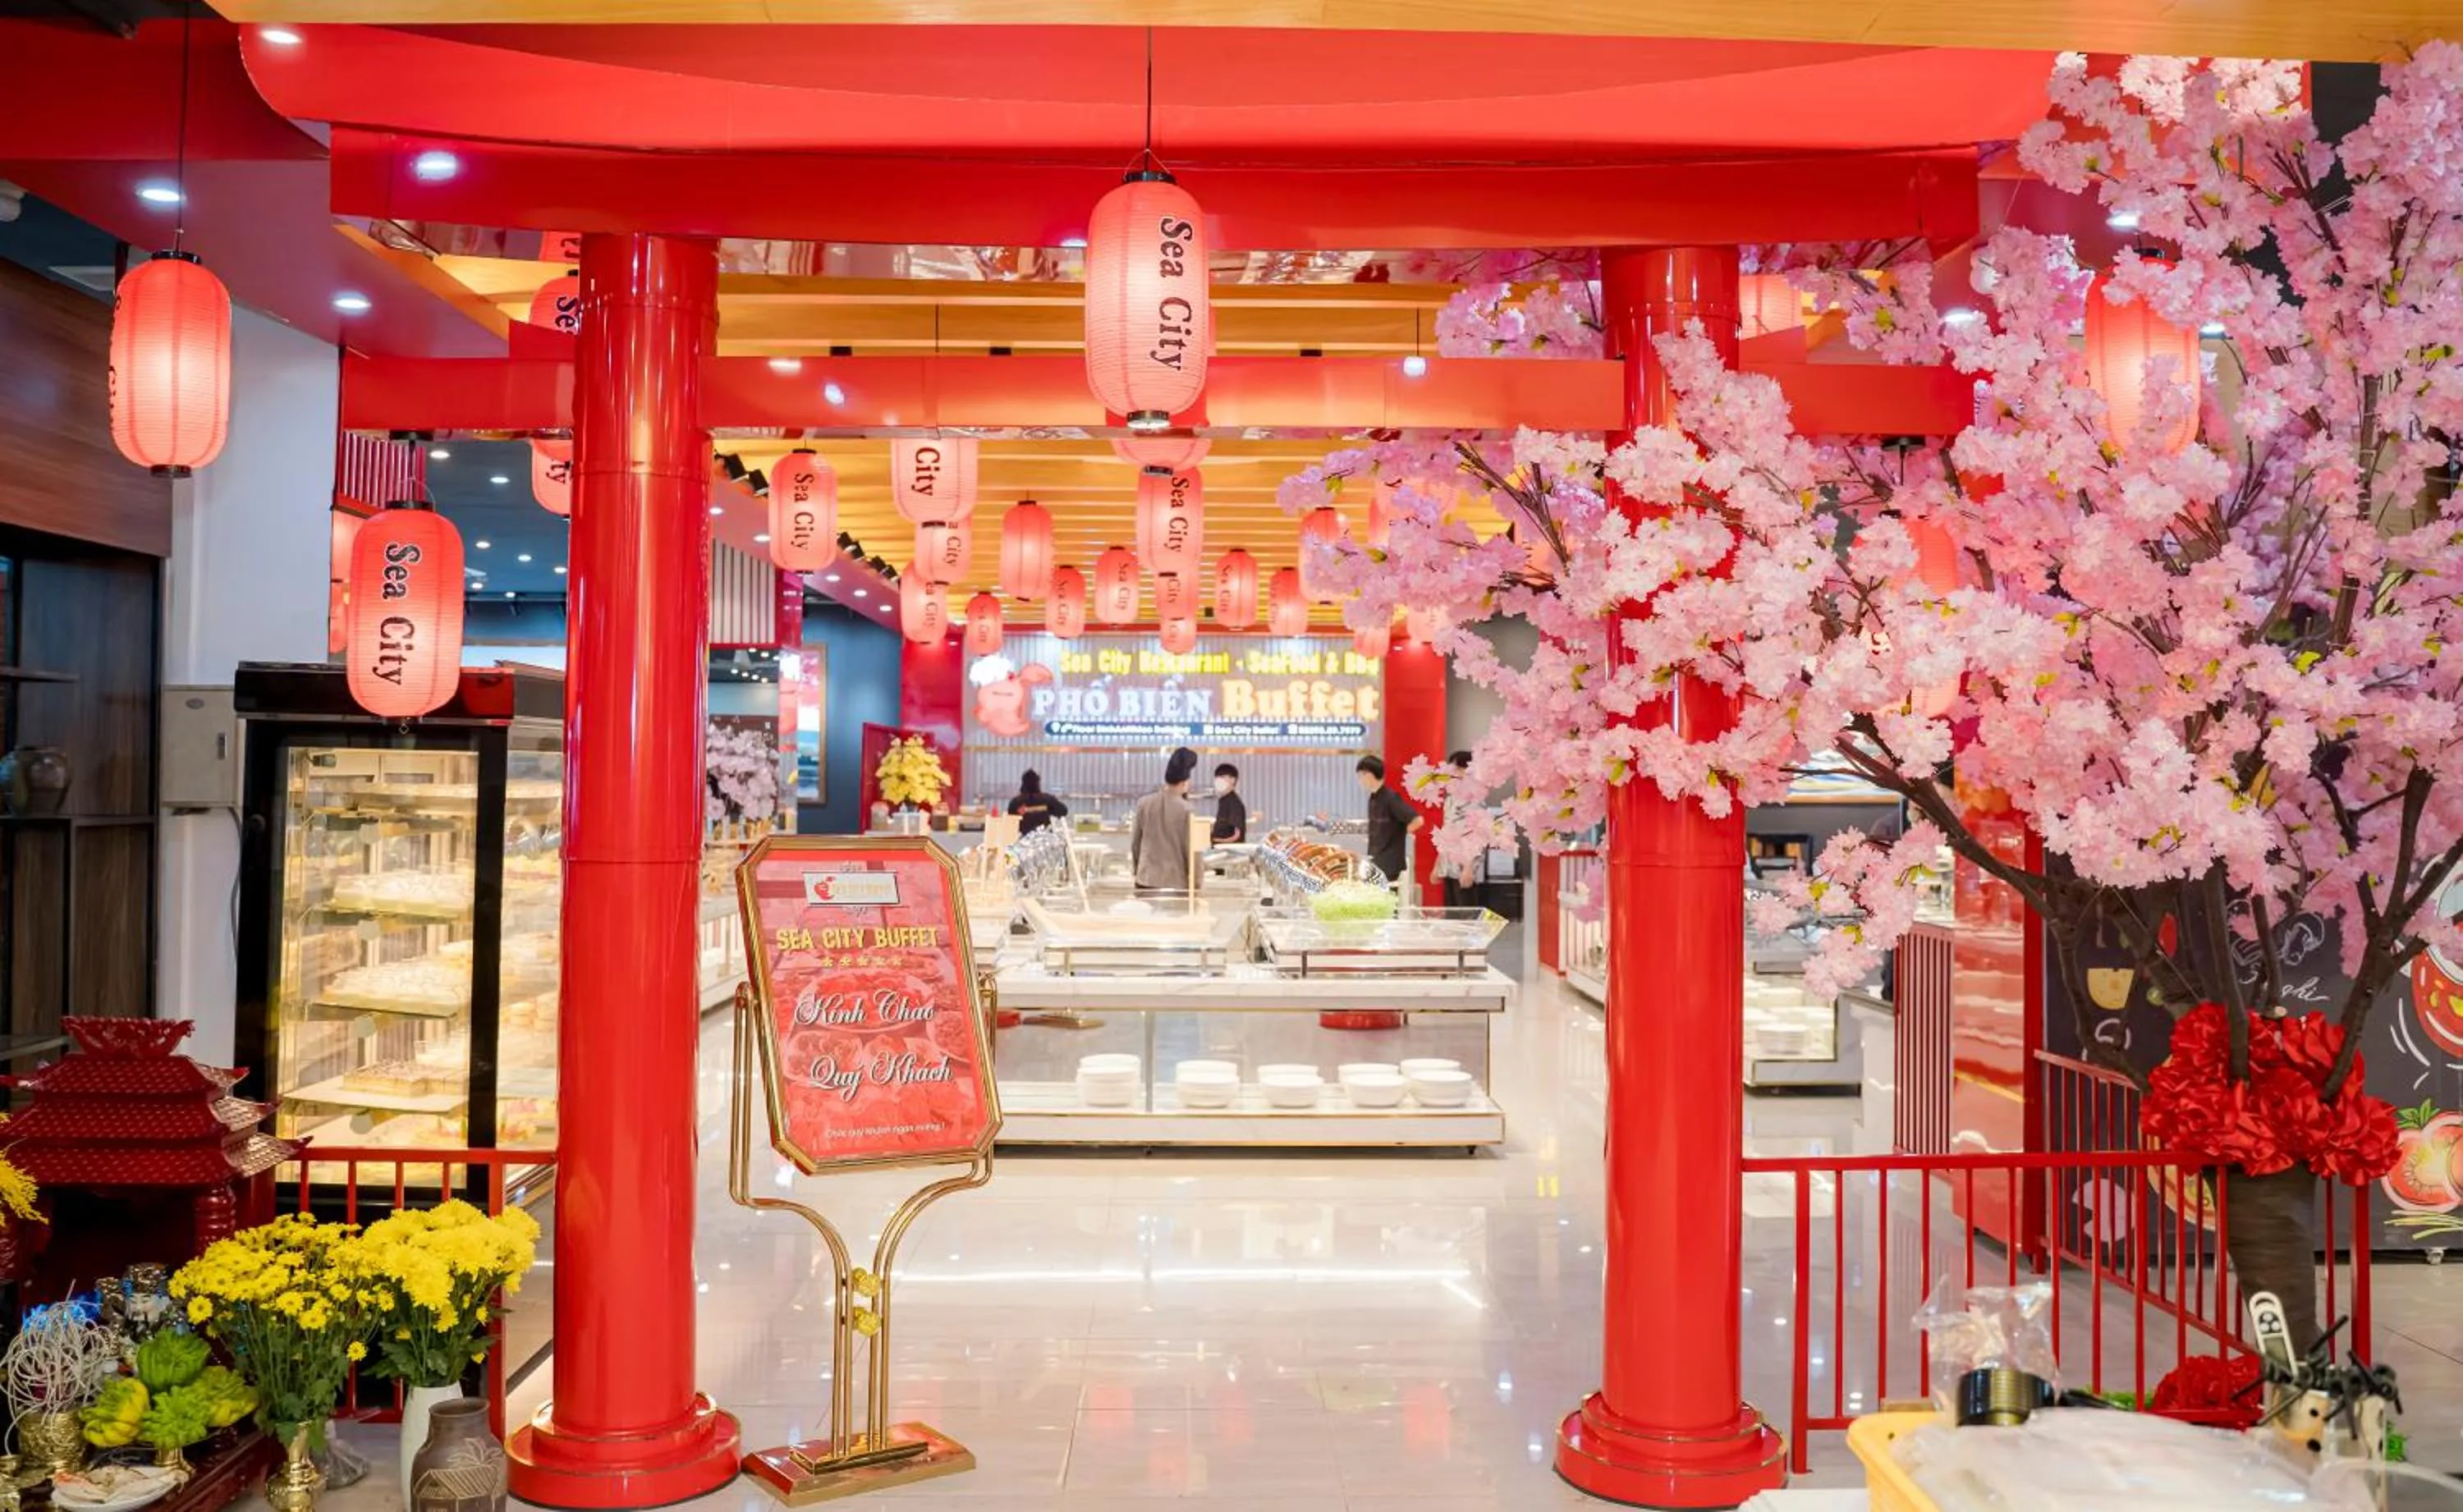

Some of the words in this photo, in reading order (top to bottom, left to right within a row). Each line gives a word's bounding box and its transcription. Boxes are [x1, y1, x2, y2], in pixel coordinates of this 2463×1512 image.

[1159, 214, 1193, 278] Sea
[1149, 296, 1192, 371] City
[794, 473, 815, 502] Sea
[911, 447, 941, 497] City
[1171, 477, 1190, 508] Sea
[791, 511, 814, 550] City
[1163, 516, 1189, 552] City
[943, 536, 961, 566] City
[383, 542, 421, 600] Sea
[372, 616, 415, 685] City
[1060, 650, 1092, 673] Sea
[1098, 648, 1131, 676] City
[1032, 674, 1111, 717] PHỐ
[1222, 680, 1381, 720] Buffet
[776, 928, 814, 949] SEA
[823, 928, 865, 948] CITY
[874, 927, 938, 947] BUFFET
[870, 1050, 952, 1086] Khách
